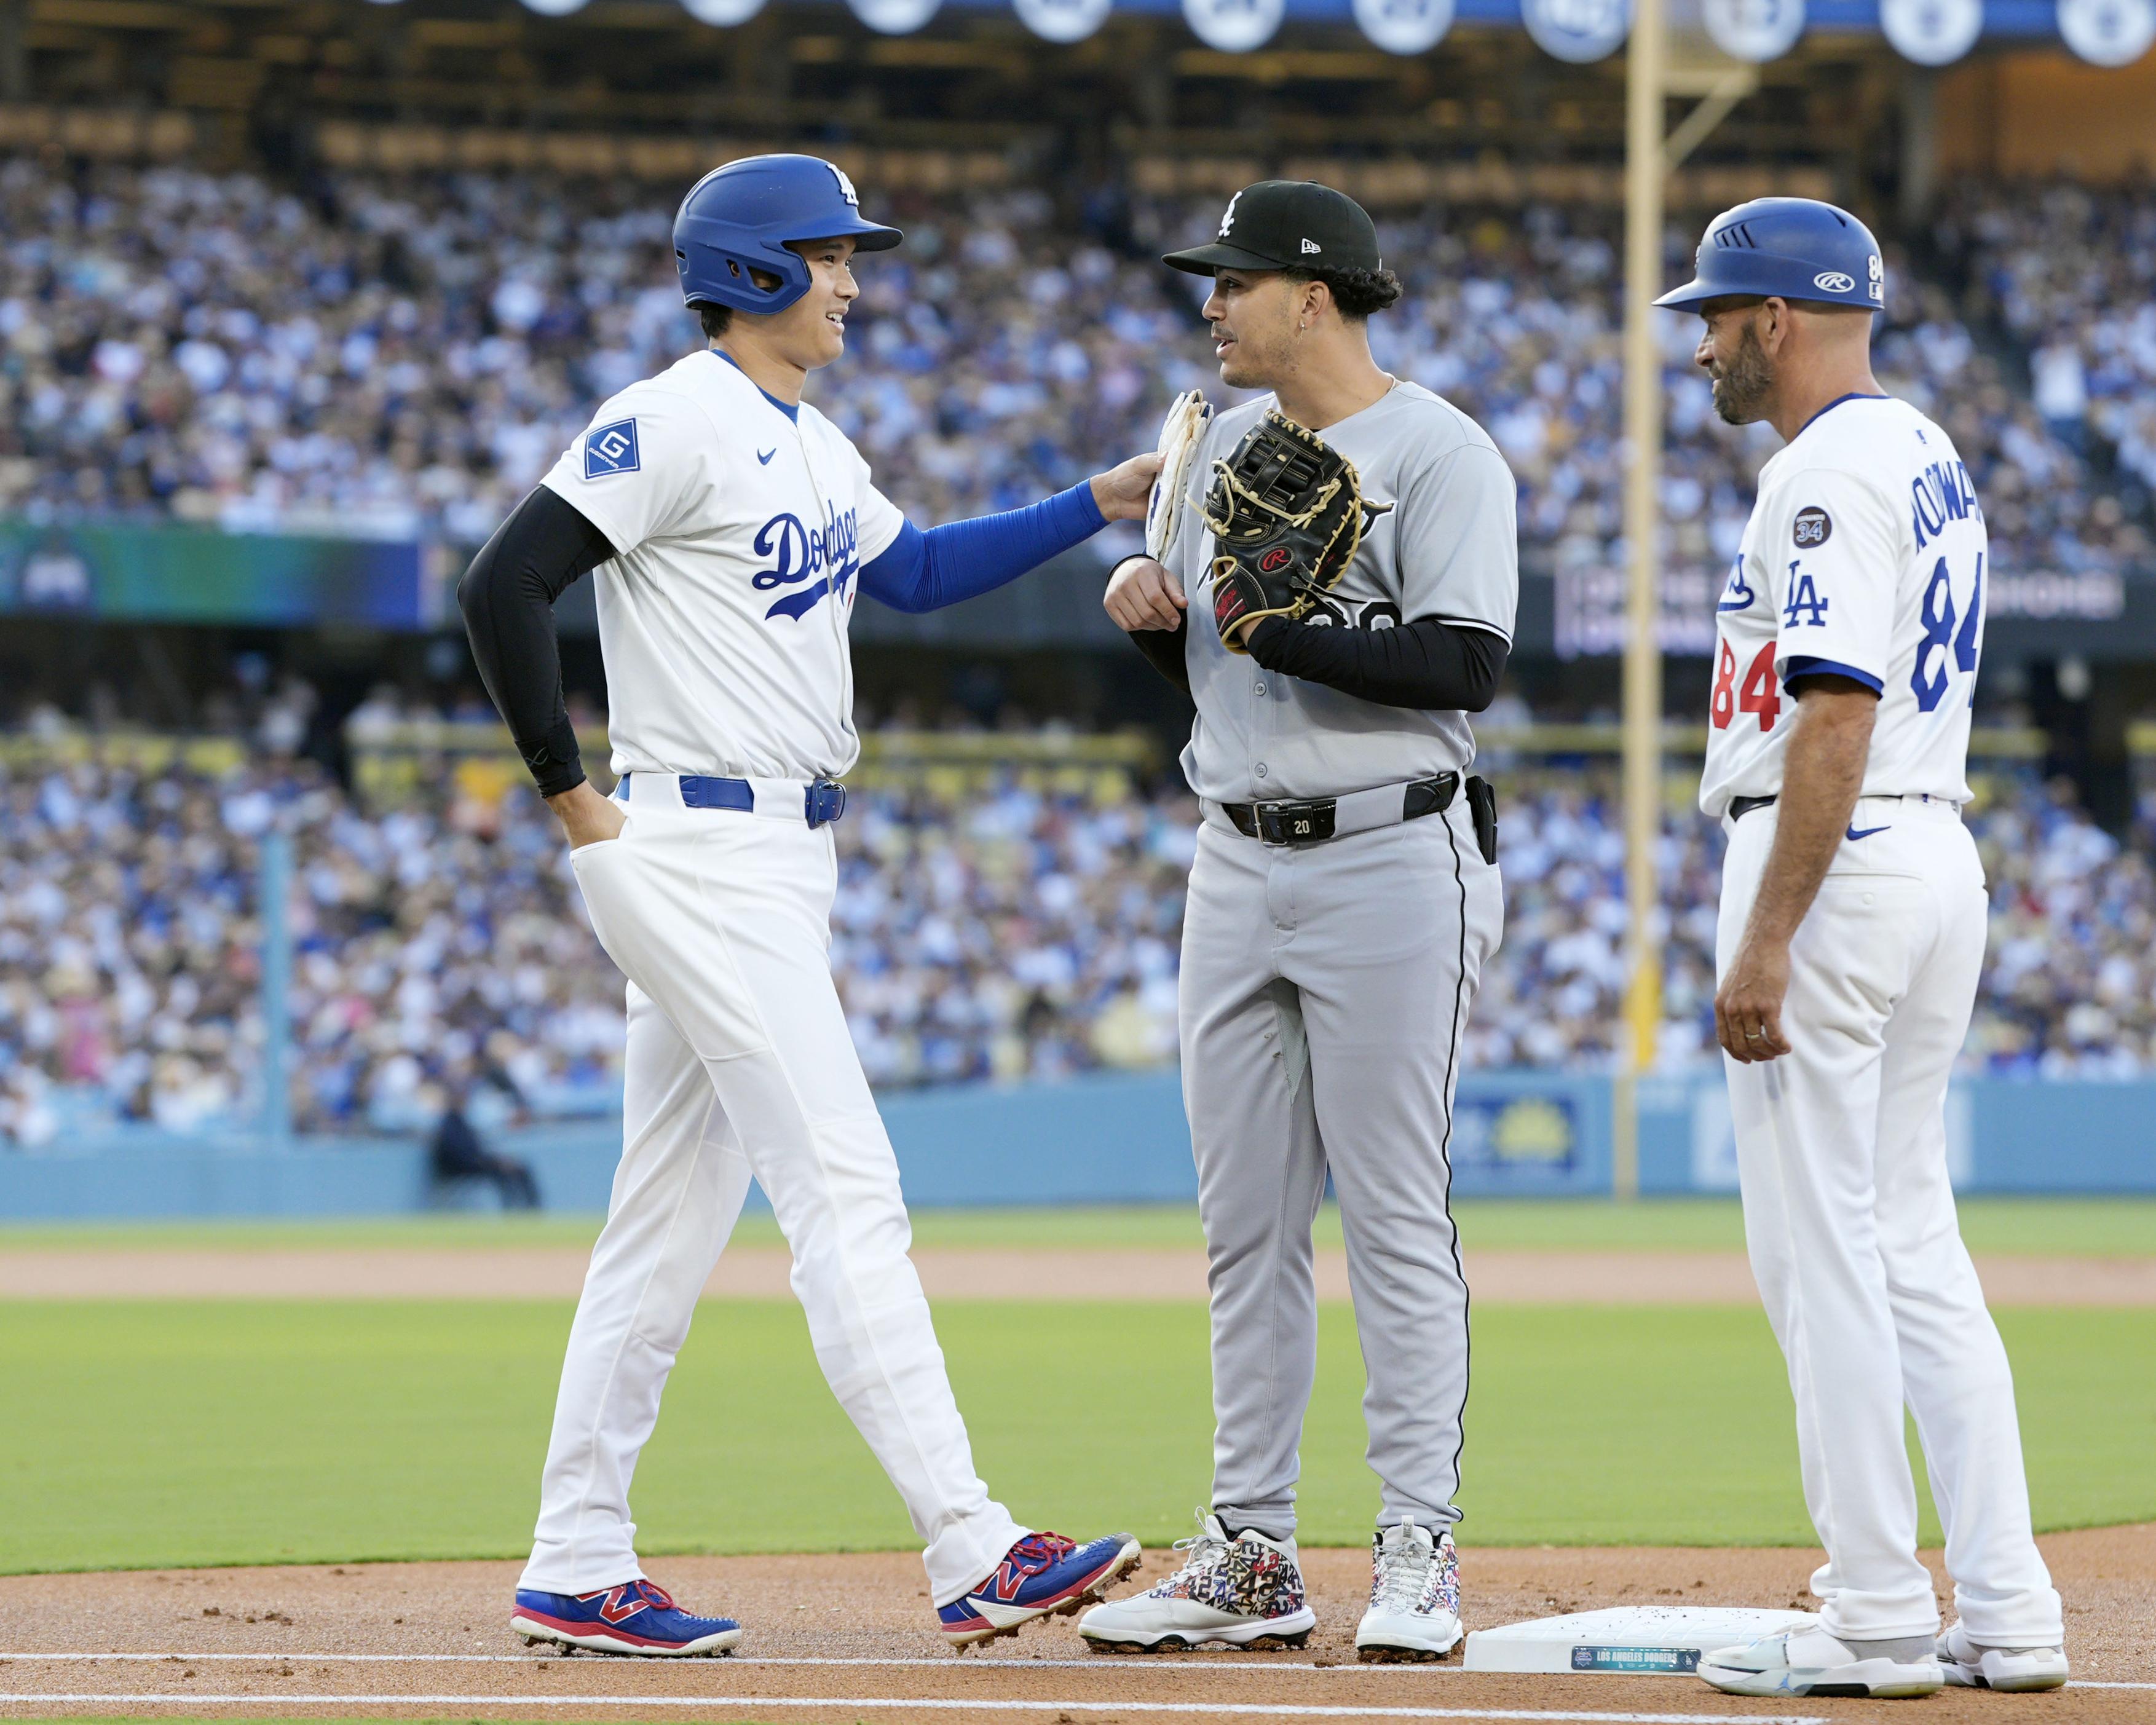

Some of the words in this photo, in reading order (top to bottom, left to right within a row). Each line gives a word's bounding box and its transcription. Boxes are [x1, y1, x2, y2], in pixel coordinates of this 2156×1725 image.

[599, 431, 630, 459] G
[1796, 520, 1824, 543] 34
[752, 499, 859, 607] Dodger
[1262, 549, 1290, 571] R
[1783, 559, 1828, 629] LA
[1911, 552, 1983, 713] 84
[1712, 637, 1781, 732] 84
[1294, 819, 1310, 834] 20
[1403, 1521, 1413, 1538] NIKE
[1235, 1570, 1279, 1601] 42
[1597, 1651, 1611, 1662] LOS
[1611, 1652, 1643, 1662] ANGELES
[1644, 1652, 1678, 1664] DODGERS
